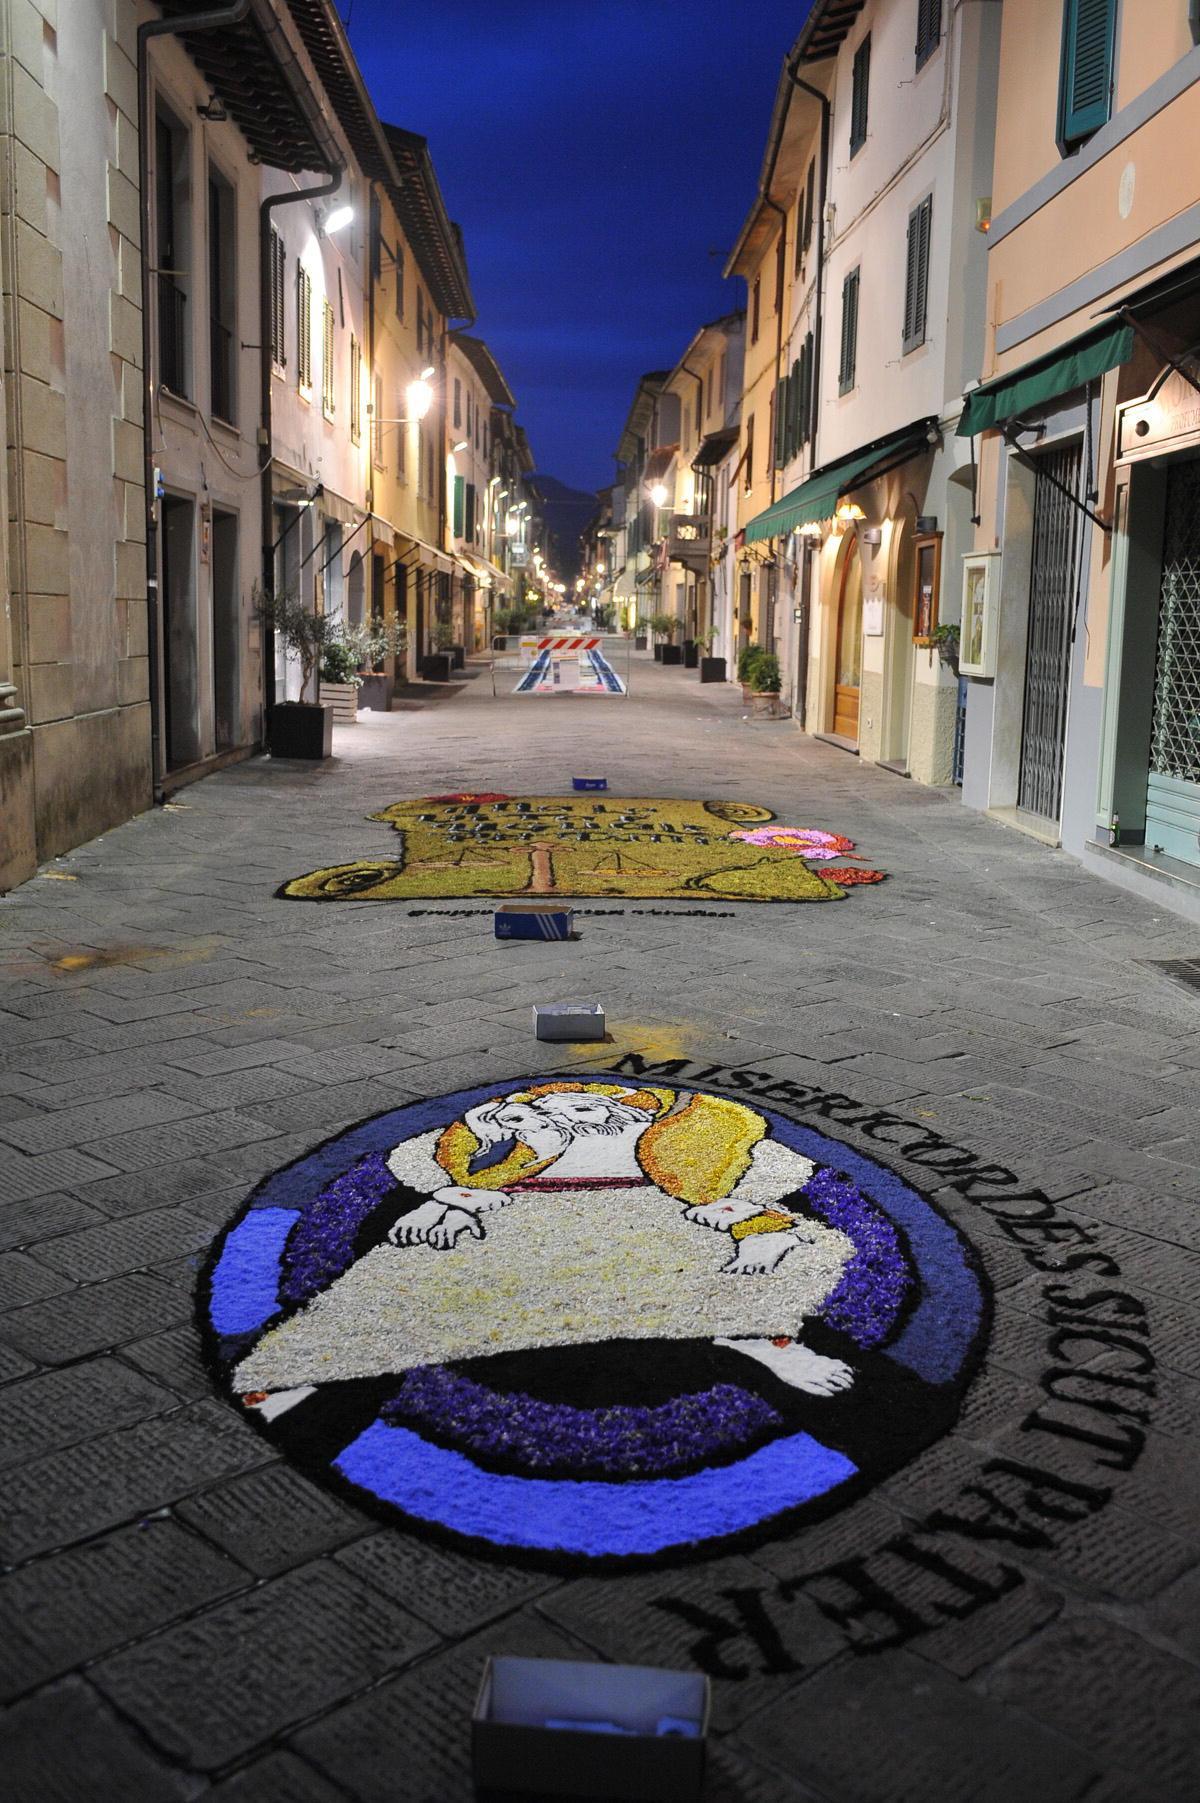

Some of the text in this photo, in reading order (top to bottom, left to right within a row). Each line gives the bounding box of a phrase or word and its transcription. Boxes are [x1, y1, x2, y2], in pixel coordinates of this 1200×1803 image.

[609, 1053, 1158, 1680] MISERICORDES SICUT PATER
